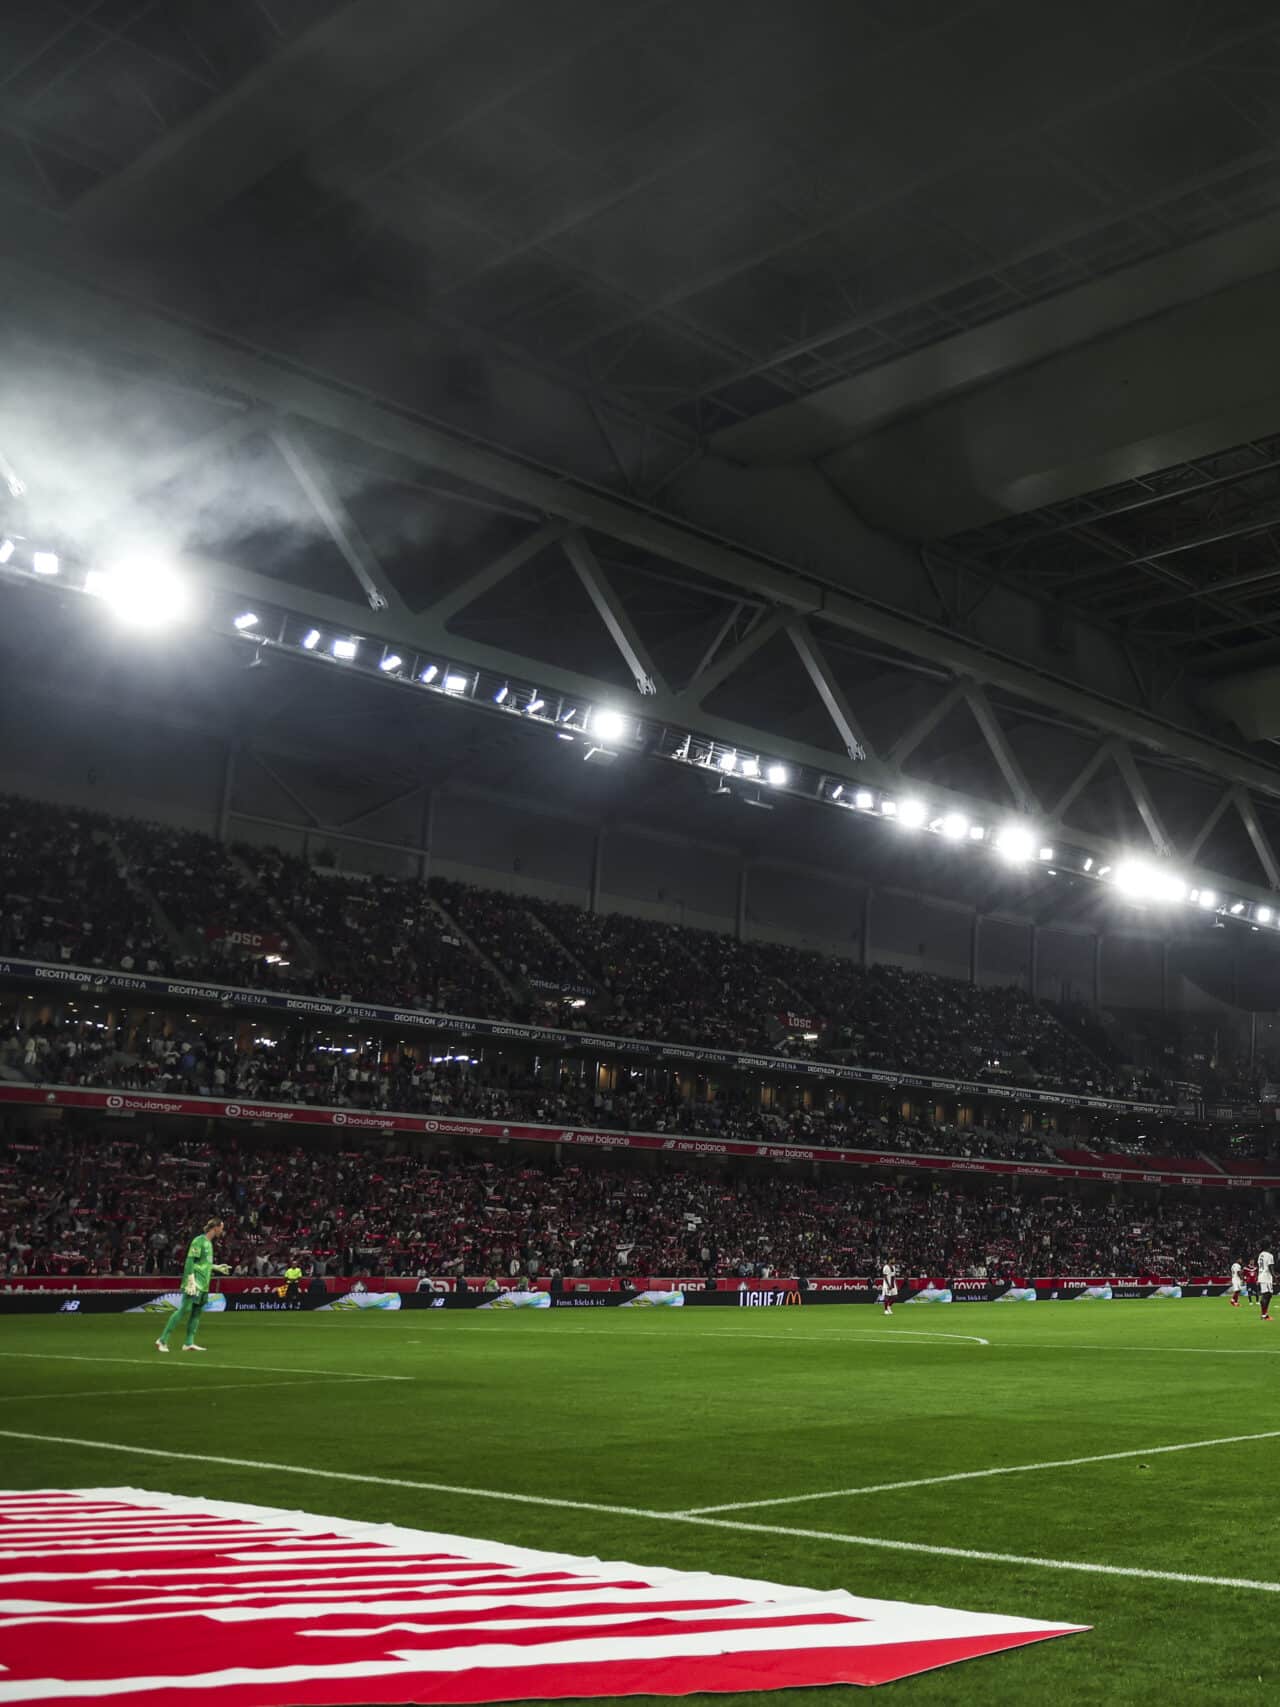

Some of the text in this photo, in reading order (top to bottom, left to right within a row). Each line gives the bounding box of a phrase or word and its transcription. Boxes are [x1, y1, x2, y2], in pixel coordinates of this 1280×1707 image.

[231, 931, 262, 946] OSC
[35, 967, 147, 990] DECATHLON ARENA
[168, 984, 268, 1005] DECATHLON ARENA
[287, 1000, 377, 1018] DECATHLON ARENA
[394, 1013, 476, 1031] DECATHLON ARENA
[125, 1097, 183, 1112] boulanger
[242, 1106, 294, 1121] boulanger
[347, 1115, 395, 1129] boulanger
[439, 1121, 483, 1135] boulanger
[577, 1134, 595, 1143] new
[596, 1134, 629, 1146] balance
[678, 1142, 697, 1150] new
[699, 1142, 726, 1152] balance
[740, 1291, 774, 1306] LIGUE
